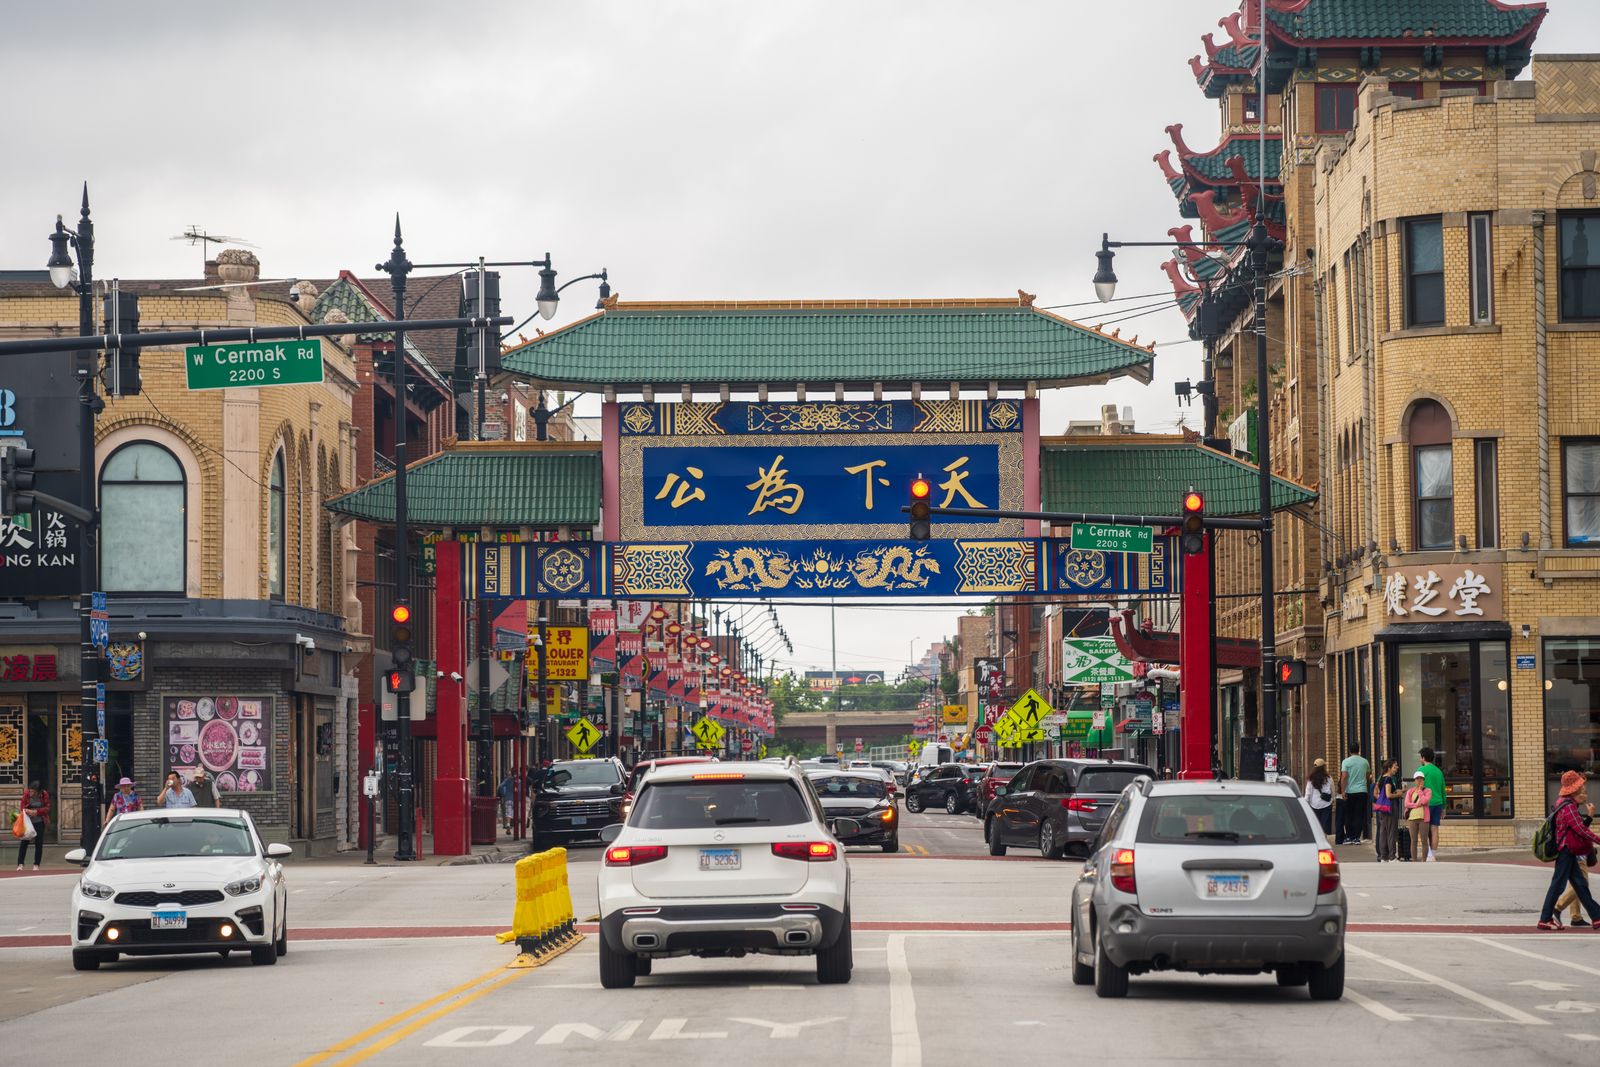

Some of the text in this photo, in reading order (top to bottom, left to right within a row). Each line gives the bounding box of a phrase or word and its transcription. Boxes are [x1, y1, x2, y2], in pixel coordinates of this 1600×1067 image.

[193, 345, 314, 366] W Cermak Rd
[229, 367, 281, 382] 2200 S
[1076, 525, 1148, 539] W Cermak Rd
[1096, 539, 1128, 549] 2200 S
[37, 554, 75, 568] KAN
[592, 618, 615, 629] CHINA
[592, 628, 615, 636] TOWN
[976, 731, 990, 739] STO
[421, 1016, 848, 1048] ONLY
